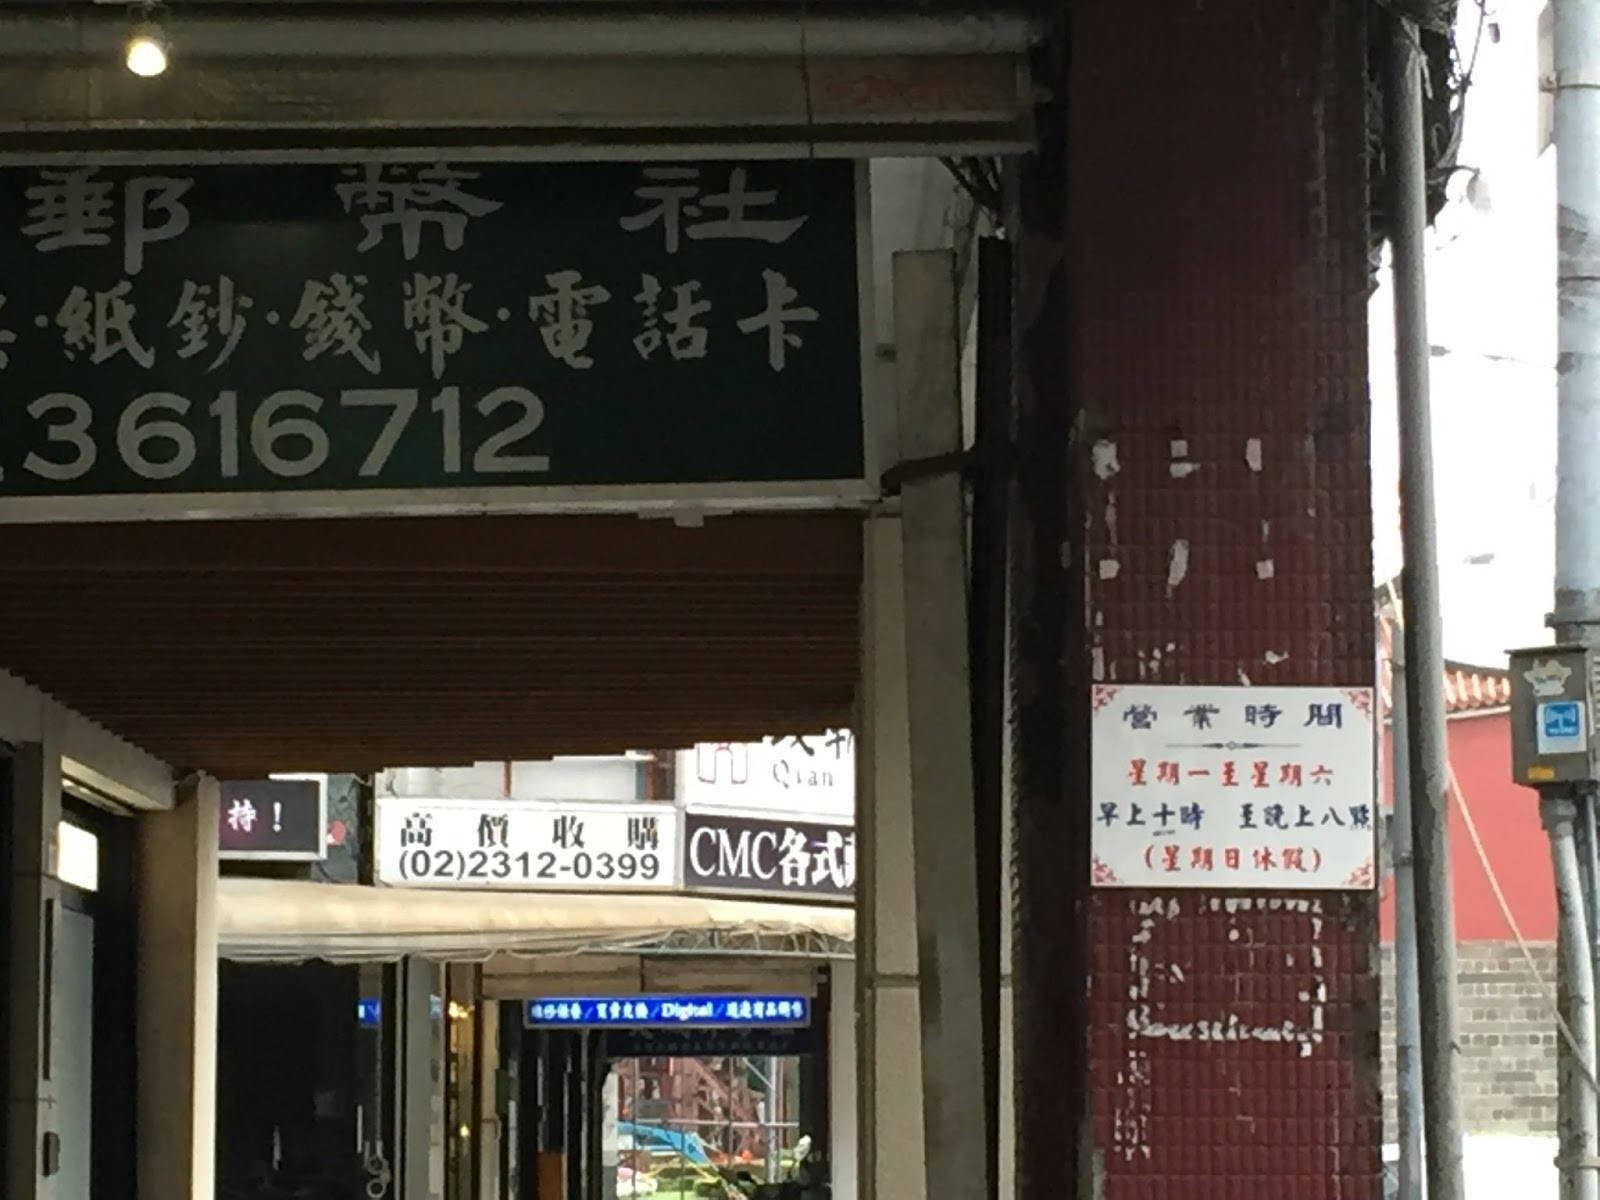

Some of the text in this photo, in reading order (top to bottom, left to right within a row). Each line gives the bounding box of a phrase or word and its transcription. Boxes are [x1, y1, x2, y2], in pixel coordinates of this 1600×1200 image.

[0, 385, 551, 482] 3616712
[1123, 703, 1343, 730] 營業時間
[772, 759, 834, 790] Qian
[1127, 758, 1334, 788] 星期一至星期六
[400, 812, 660, 850] 高價收購
[398, 850, 660, 880] (02)2312-0399
[1144, 844, 1321, 872] (星期日休假)
